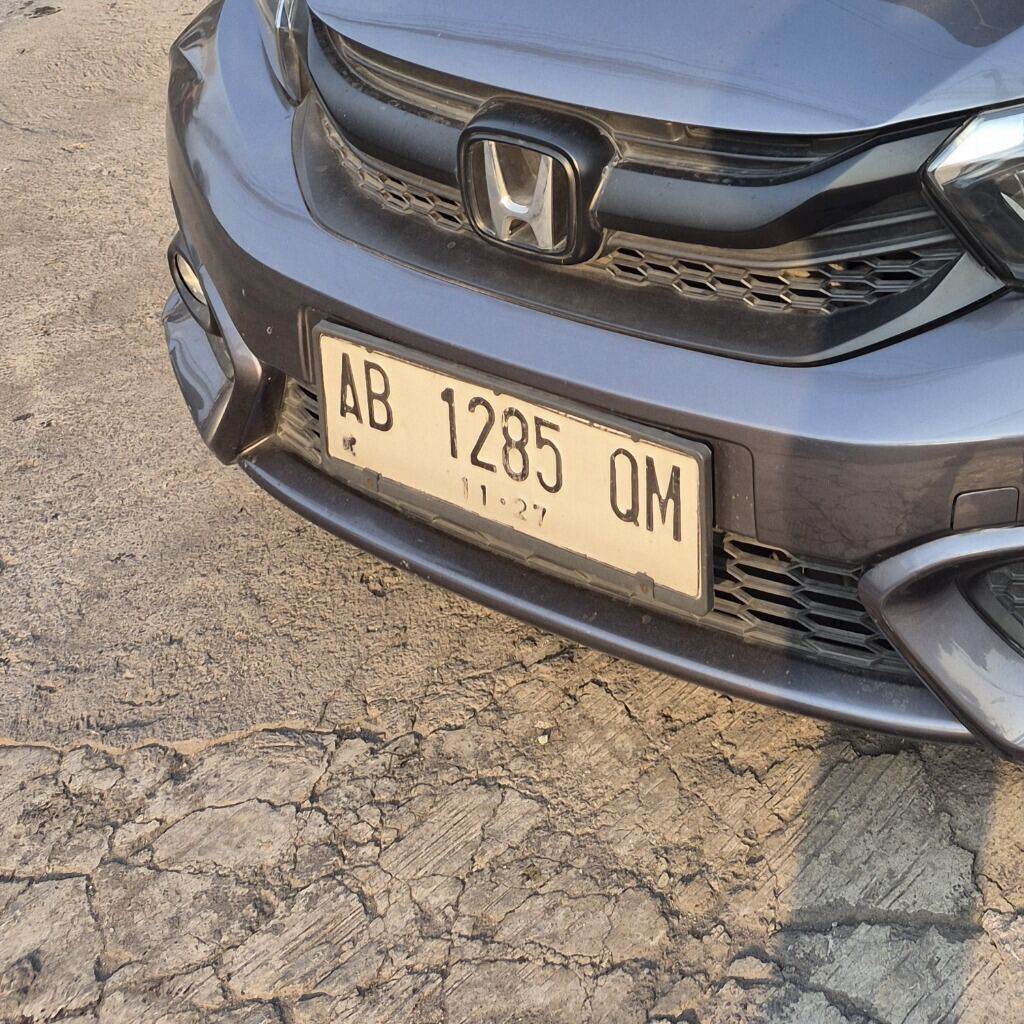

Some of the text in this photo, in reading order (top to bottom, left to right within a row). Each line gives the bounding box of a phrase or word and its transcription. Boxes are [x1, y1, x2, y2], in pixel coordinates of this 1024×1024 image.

[340, 352, 682, 543] AB 1285 QM
